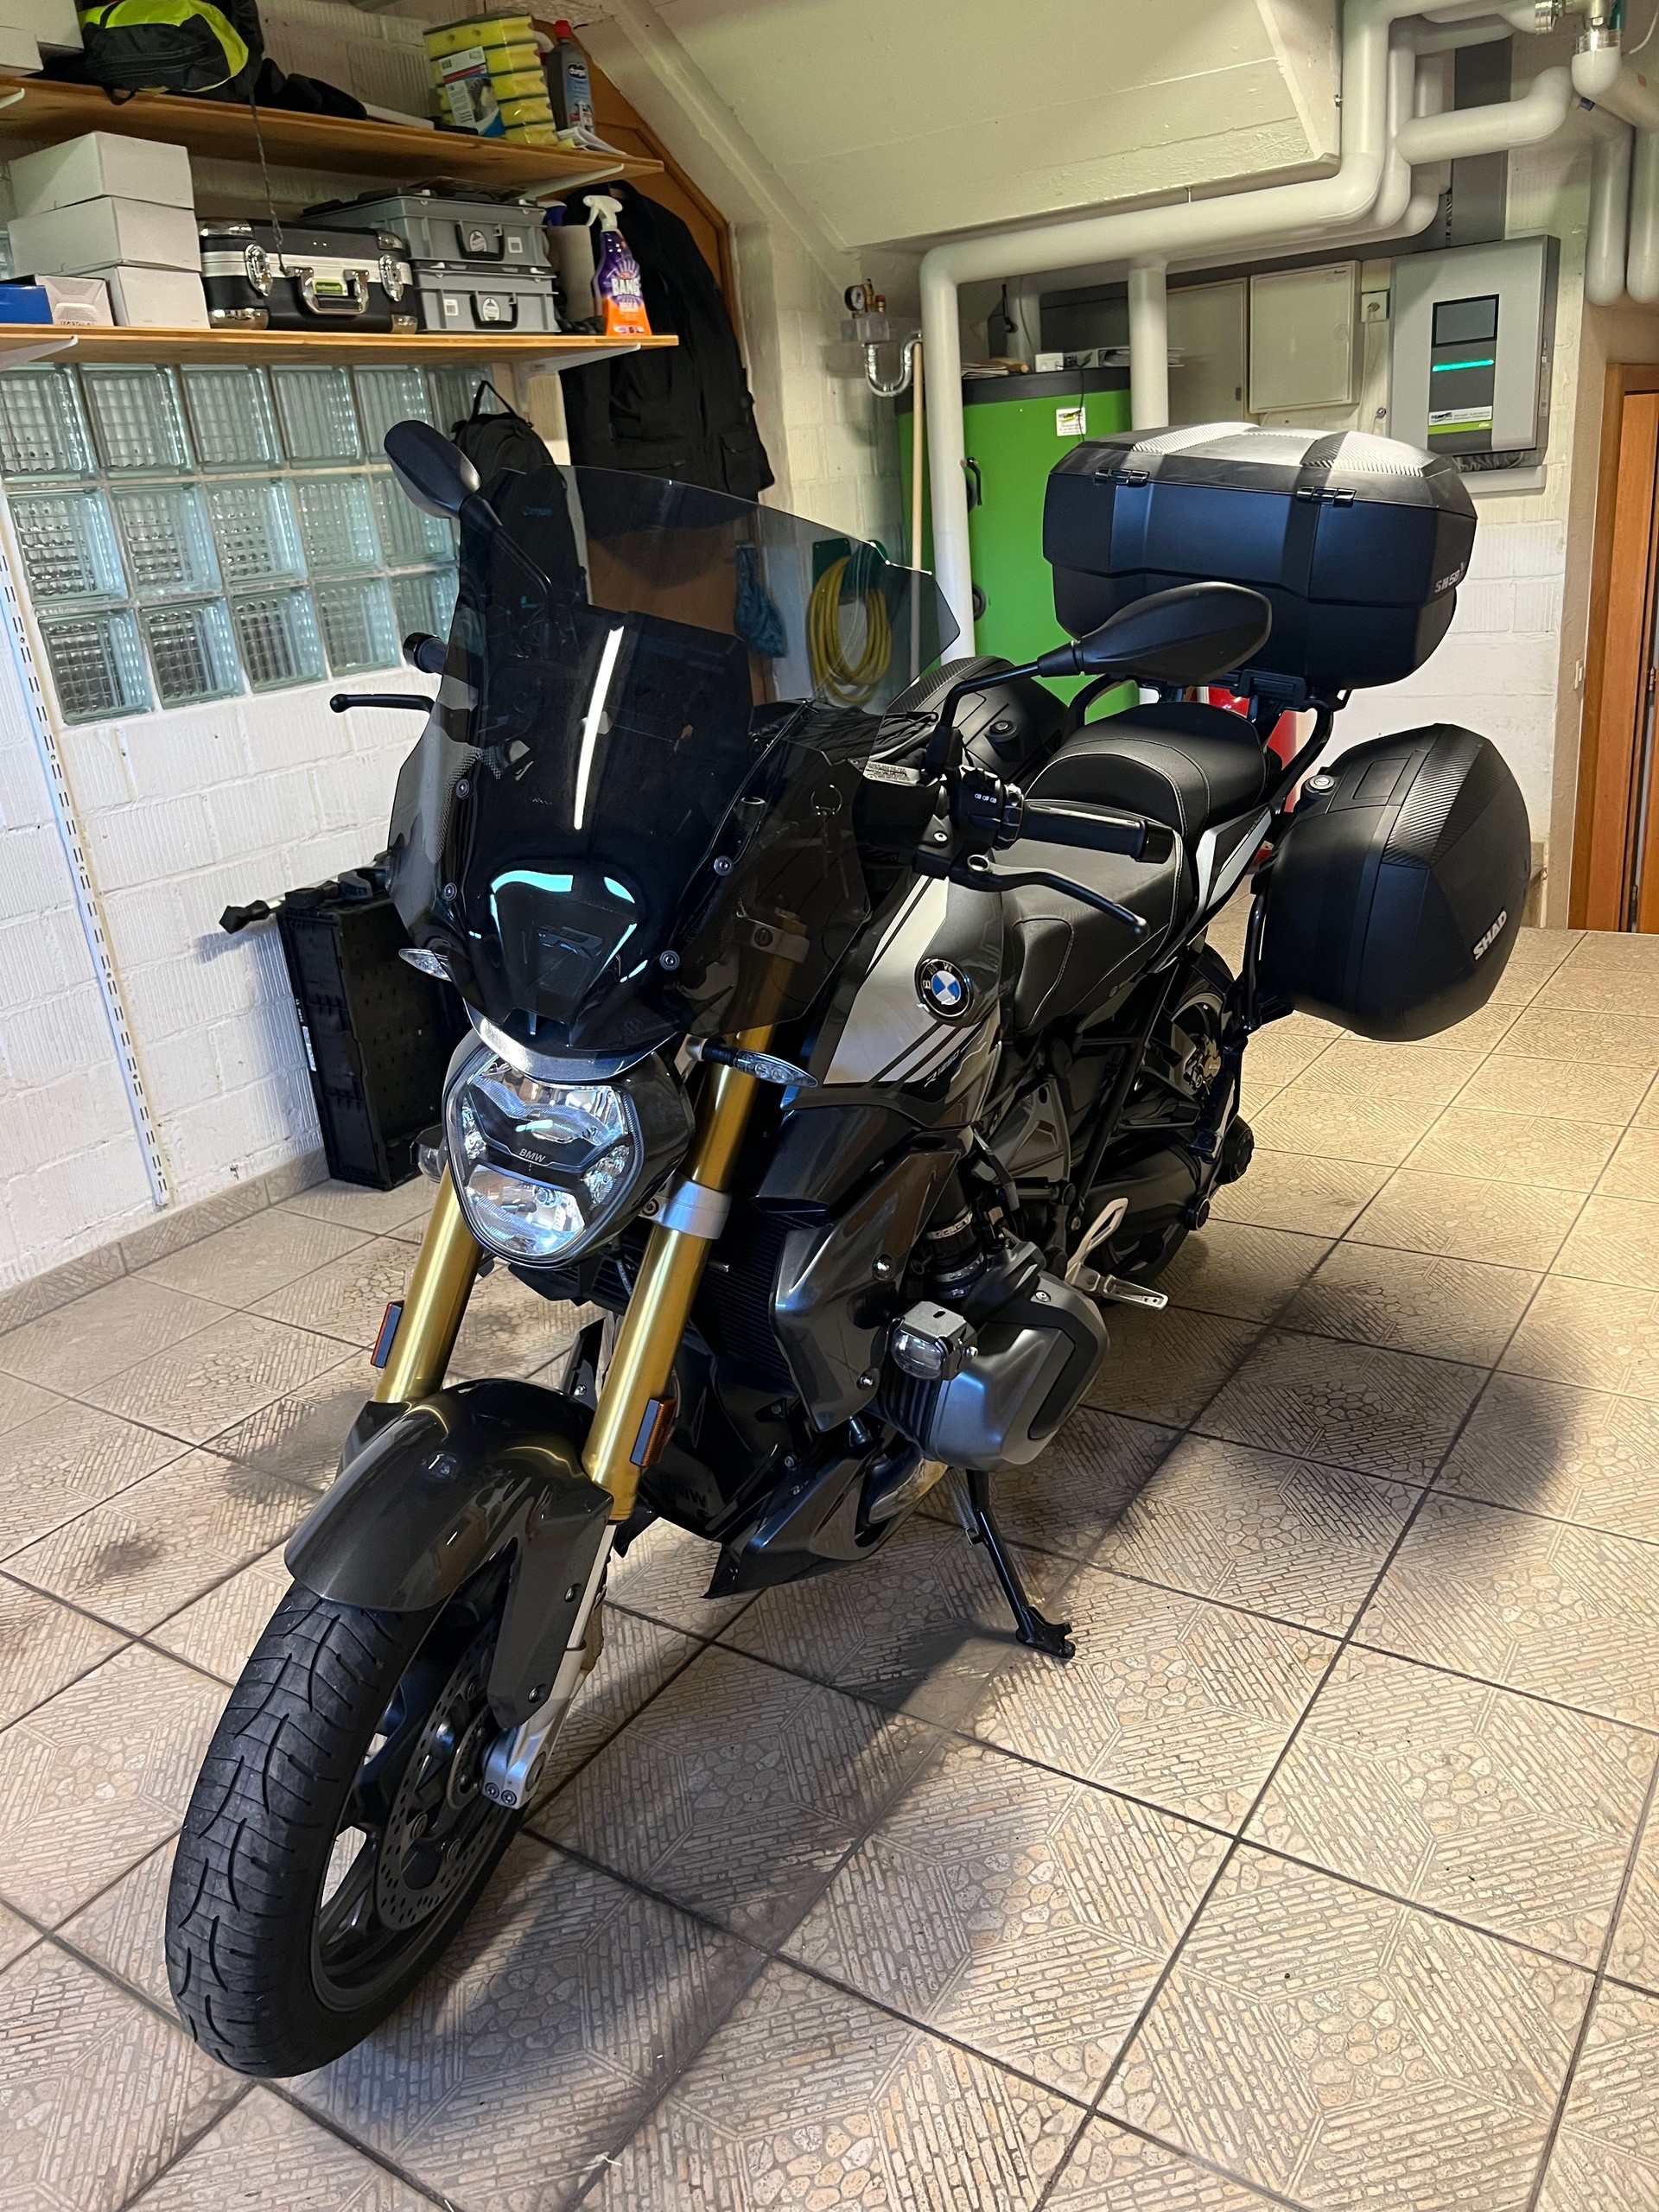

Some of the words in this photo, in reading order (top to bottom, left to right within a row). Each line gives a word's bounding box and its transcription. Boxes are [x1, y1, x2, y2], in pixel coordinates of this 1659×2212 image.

[1473, 910, 1507, 960] SHAD
[922, 962, 953, 990] BMW
[519, 1148, 546, 1162] BMW
